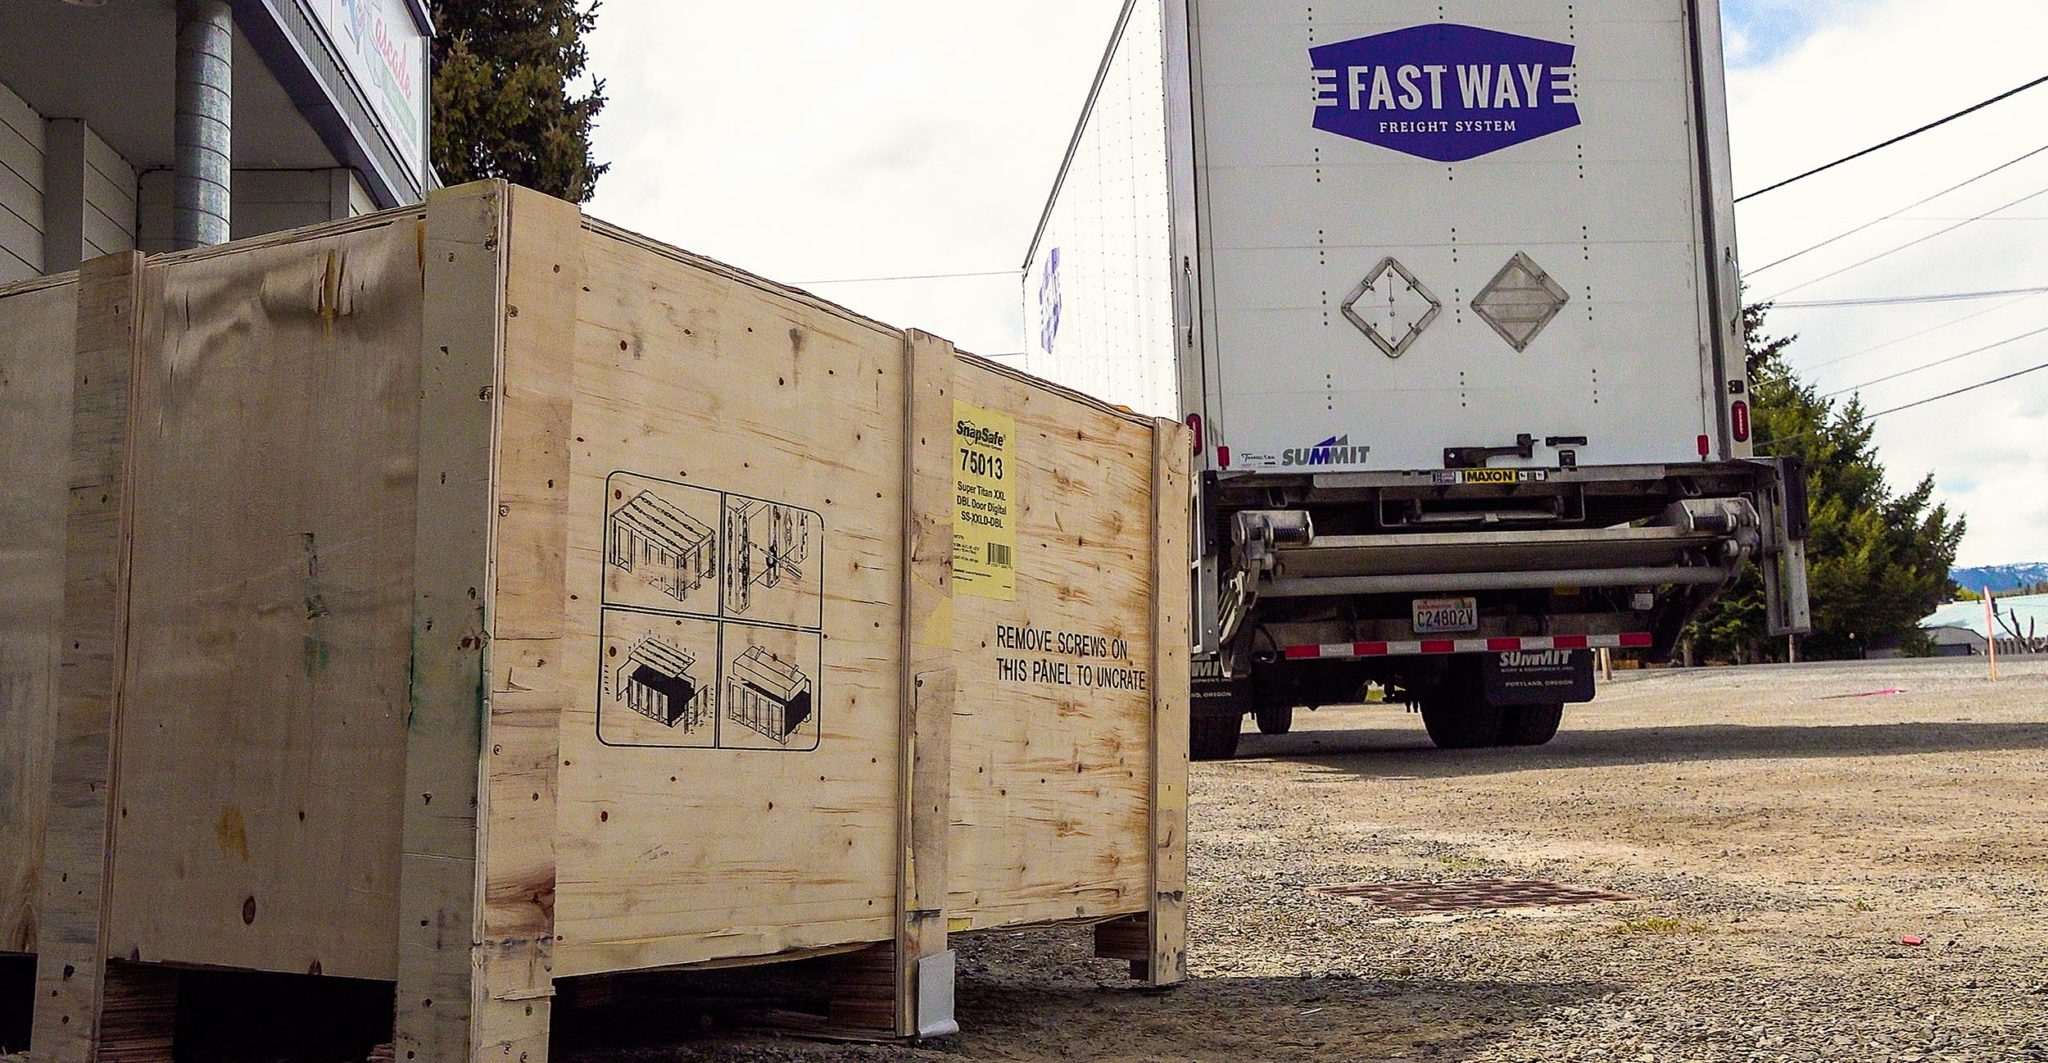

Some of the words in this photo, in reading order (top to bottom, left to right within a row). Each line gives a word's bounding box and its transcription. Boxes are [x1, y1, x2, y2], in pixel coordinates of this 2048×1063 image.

[1348, 65, 1447, 110] FAST
[1456, 64, 1543, 109] WAY
[1379, 121, 1448, 133] FREIGHT
[1455, 120, 1517, 132] SYSTEM
[960, 448, 1003, 480] 75013
[1281, 446, 1370, 466] SUMMIT
[1466, 470, 1513, 482] MAXON
[957, 480, 976, 494] Super
[977, 485, 993, 498] Titan
[956, 495, 971, 507] DBL
[971, 498, 987, 511] Door
[987, 502, 1007, 516] Digital
[1417, 609, 1474, 627] C24802V
[996, 624, 1052, 652] REMOVE
[1057, 632, 1107, 658] SCREWS
[1111, 638, 1128, 660] ON
[1499, 649, 1573, 667] SUMMIT
[996, 657, 1027, 682] THIS
[1032, 660, 1072, 685] PANEL
[1076, 665, 1093, 687] TO
[1097, 667, 1146, 690] UNCRATE
